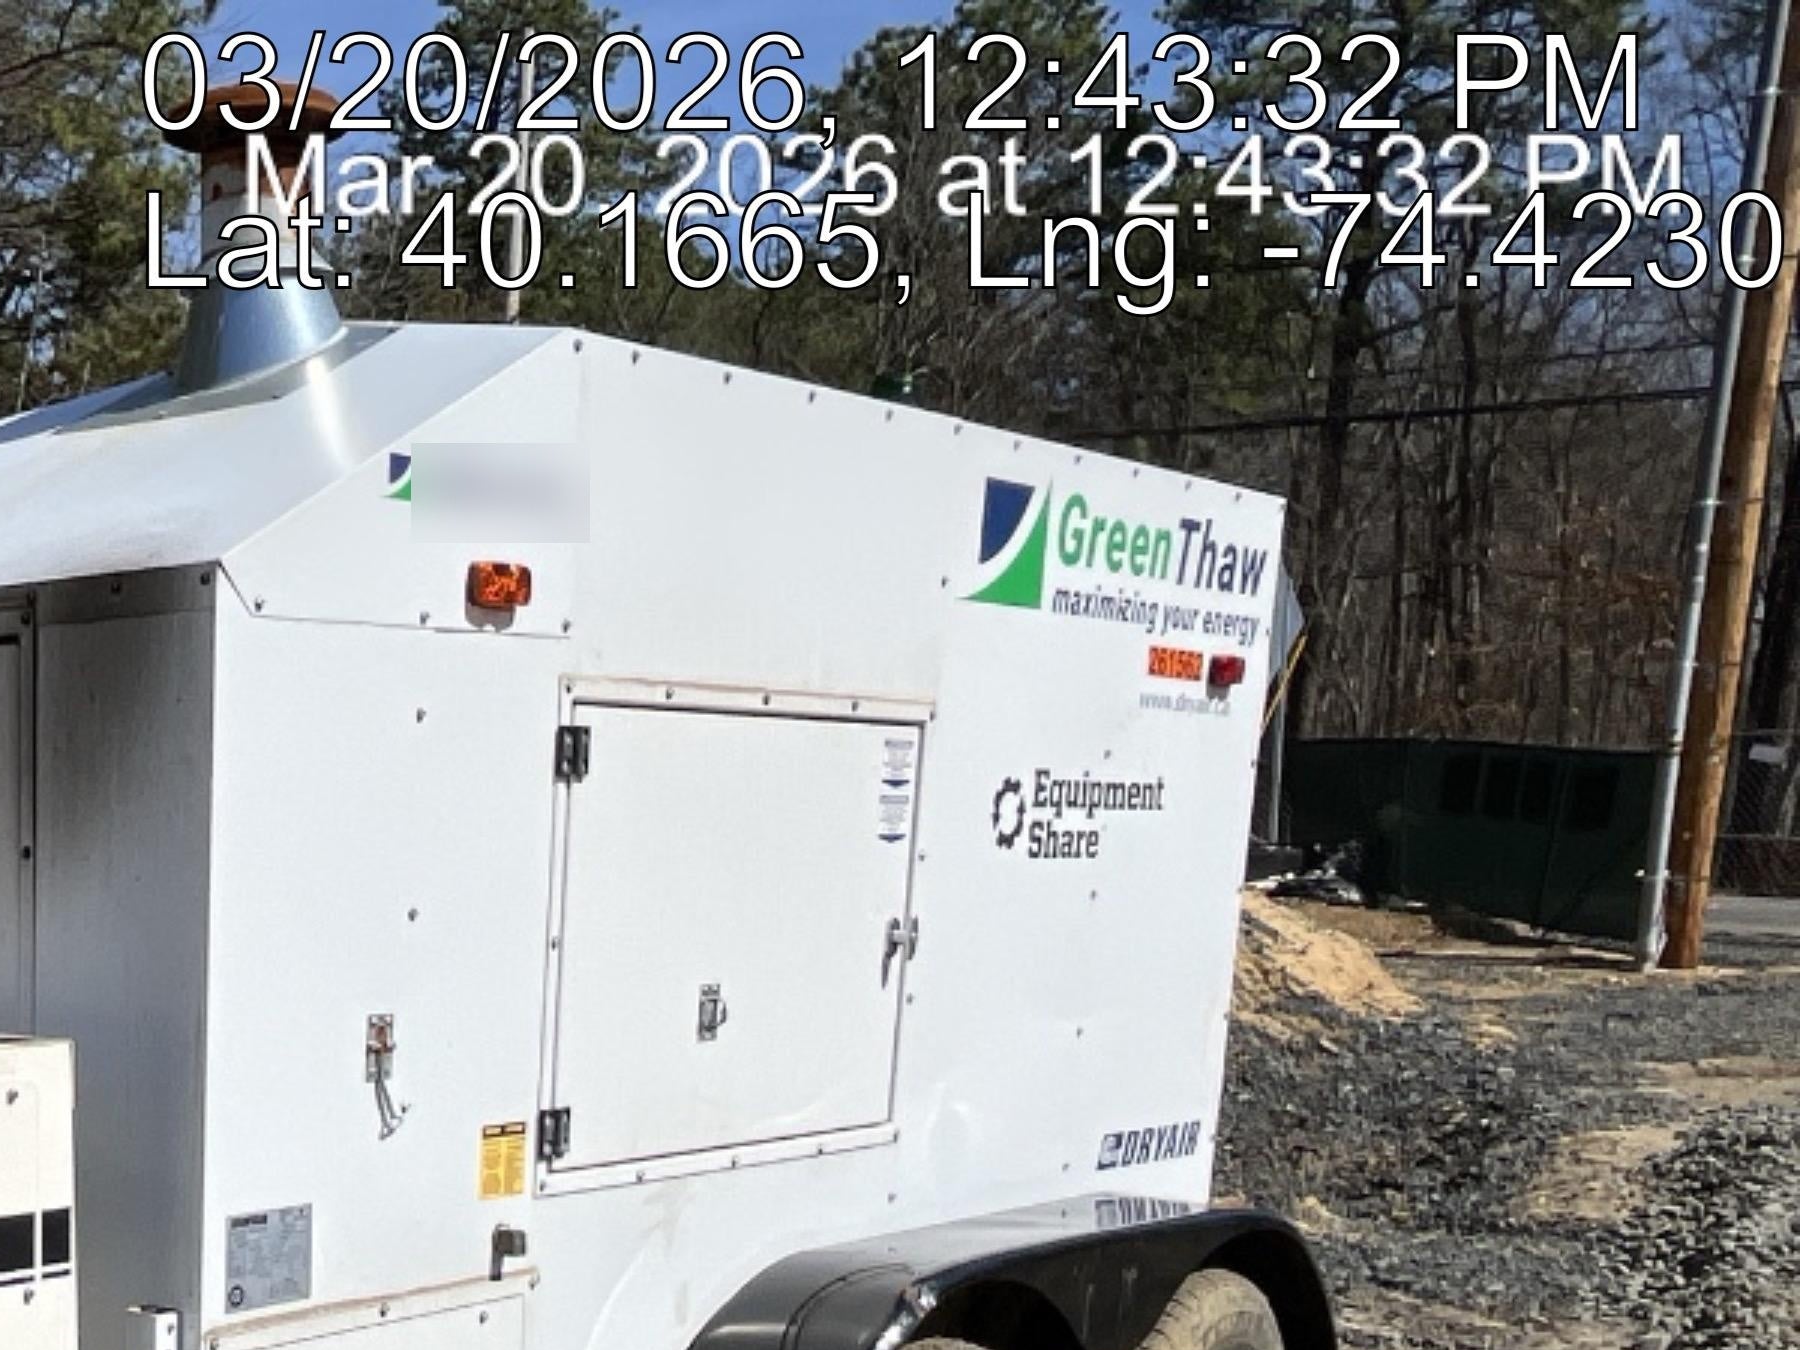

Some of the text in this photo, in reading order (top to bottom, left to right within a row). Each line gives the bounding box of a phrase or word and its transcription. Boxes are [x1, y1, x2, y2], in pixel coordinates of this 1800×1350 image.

[1052, 584, 1261, 648] maximizing your energy
[1031, 767, 1165, 819] Equipment
[1028, 819, 1100, 859] Share
[1120, 1119, 1200, 1168] DRYAIR
